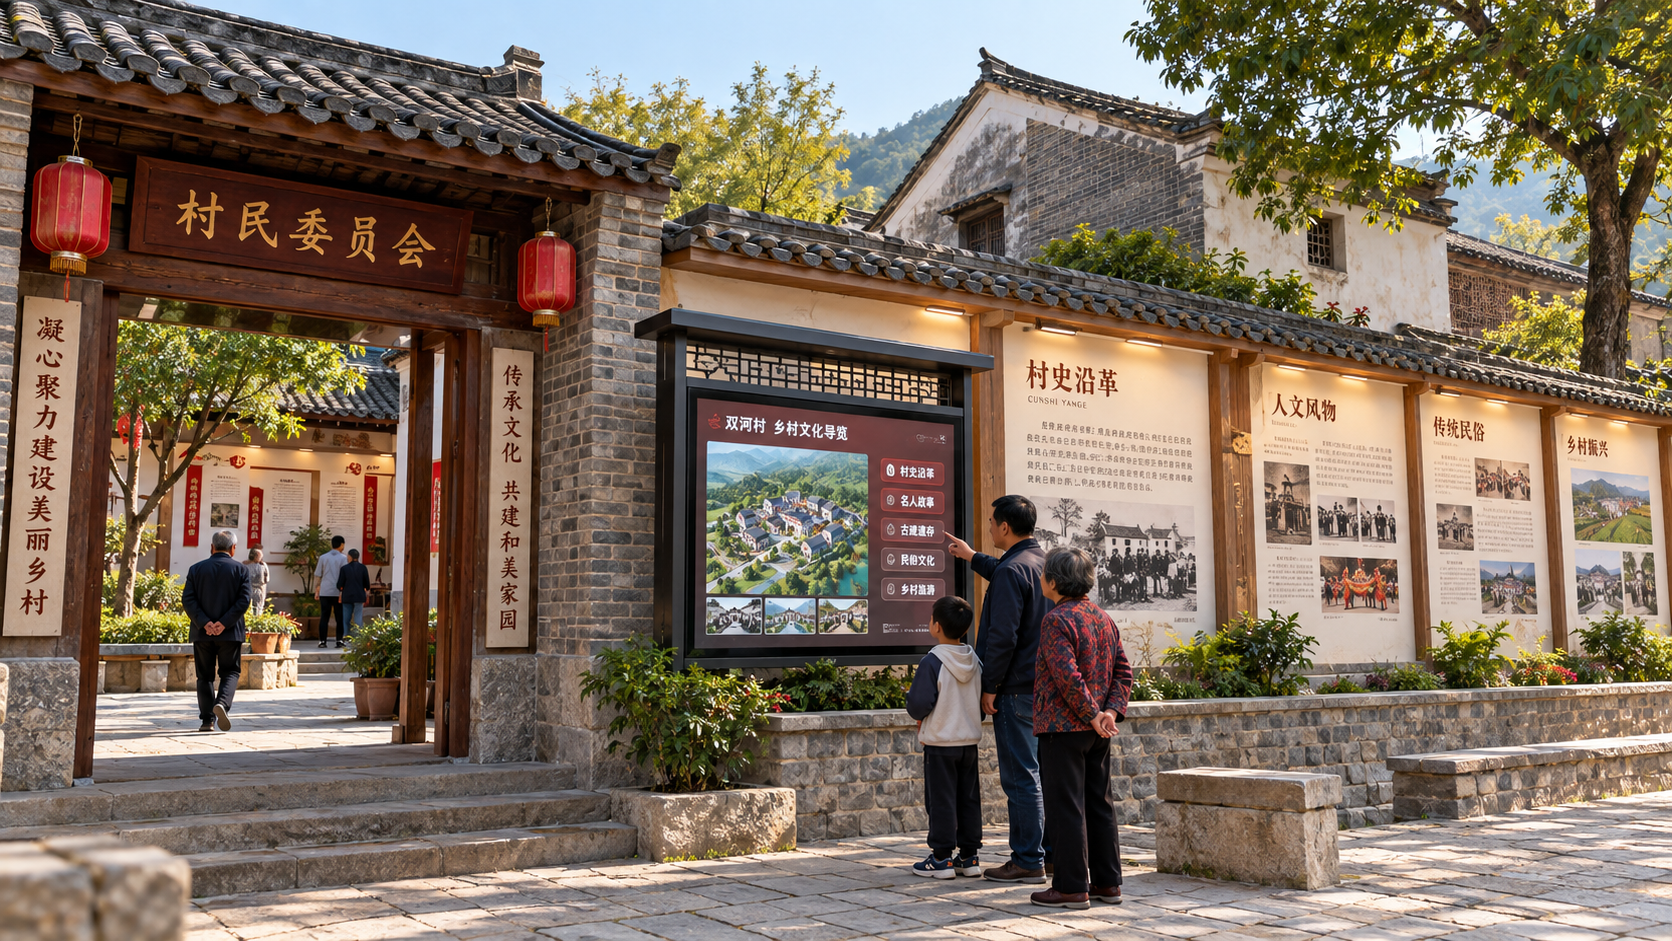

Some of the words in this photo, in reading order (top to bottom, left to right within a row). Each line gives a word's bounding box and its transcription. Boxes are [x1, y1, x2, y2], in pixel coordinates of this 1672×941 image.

[176, 189, 436, 268] 村民委员会
[1026, 359, 1119, 397] 村史沿革
[502, 364, 523, 463] 传承文化
[1062, 400, 1087, 409] YANGE
[1272, 393, 1336, 422] 人文风物
[725, 415, 766, 434] 双河村
[774, 419, 848, 440] 乡村文化导览
[1433, 416, 1485, 442] 传统民俗
[1567, 435, 1608, 458] 乡村振兴
[20, 316, 65, 616] 凝心聚力建设美丽乡村
[499, 480, 521, 630] 共建和美家园
